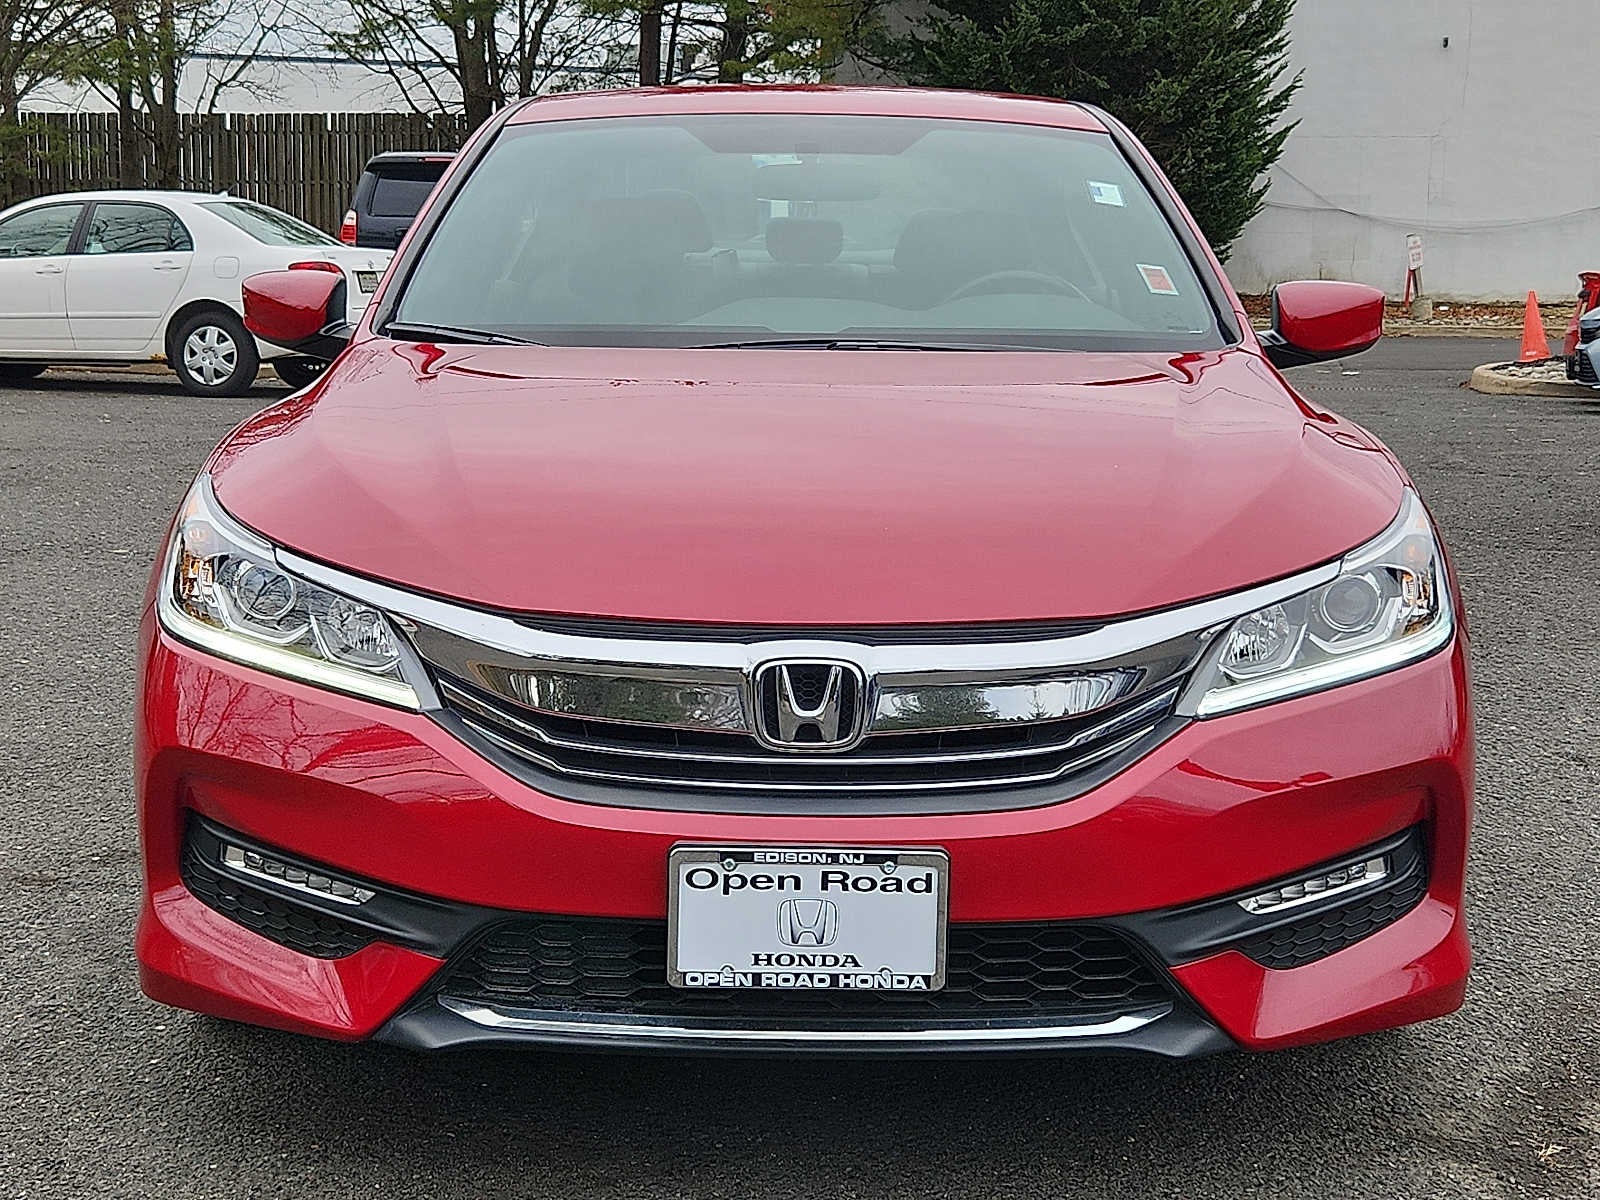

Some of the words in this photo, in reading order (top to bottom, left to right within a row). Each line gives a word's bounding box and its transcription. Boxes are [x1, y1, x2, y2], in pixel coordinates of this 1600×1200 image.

[838, 853, 865, 865] NJ
[685, 867, 802, 896] Open
[820, 870, 933, 894] Road
[751, 952, 862, 968] HONDA
[685, 972, 752, 987] OPEN
[760, 973, 831, 988] ROAD
[838, 973, 928, 990] HONDA
